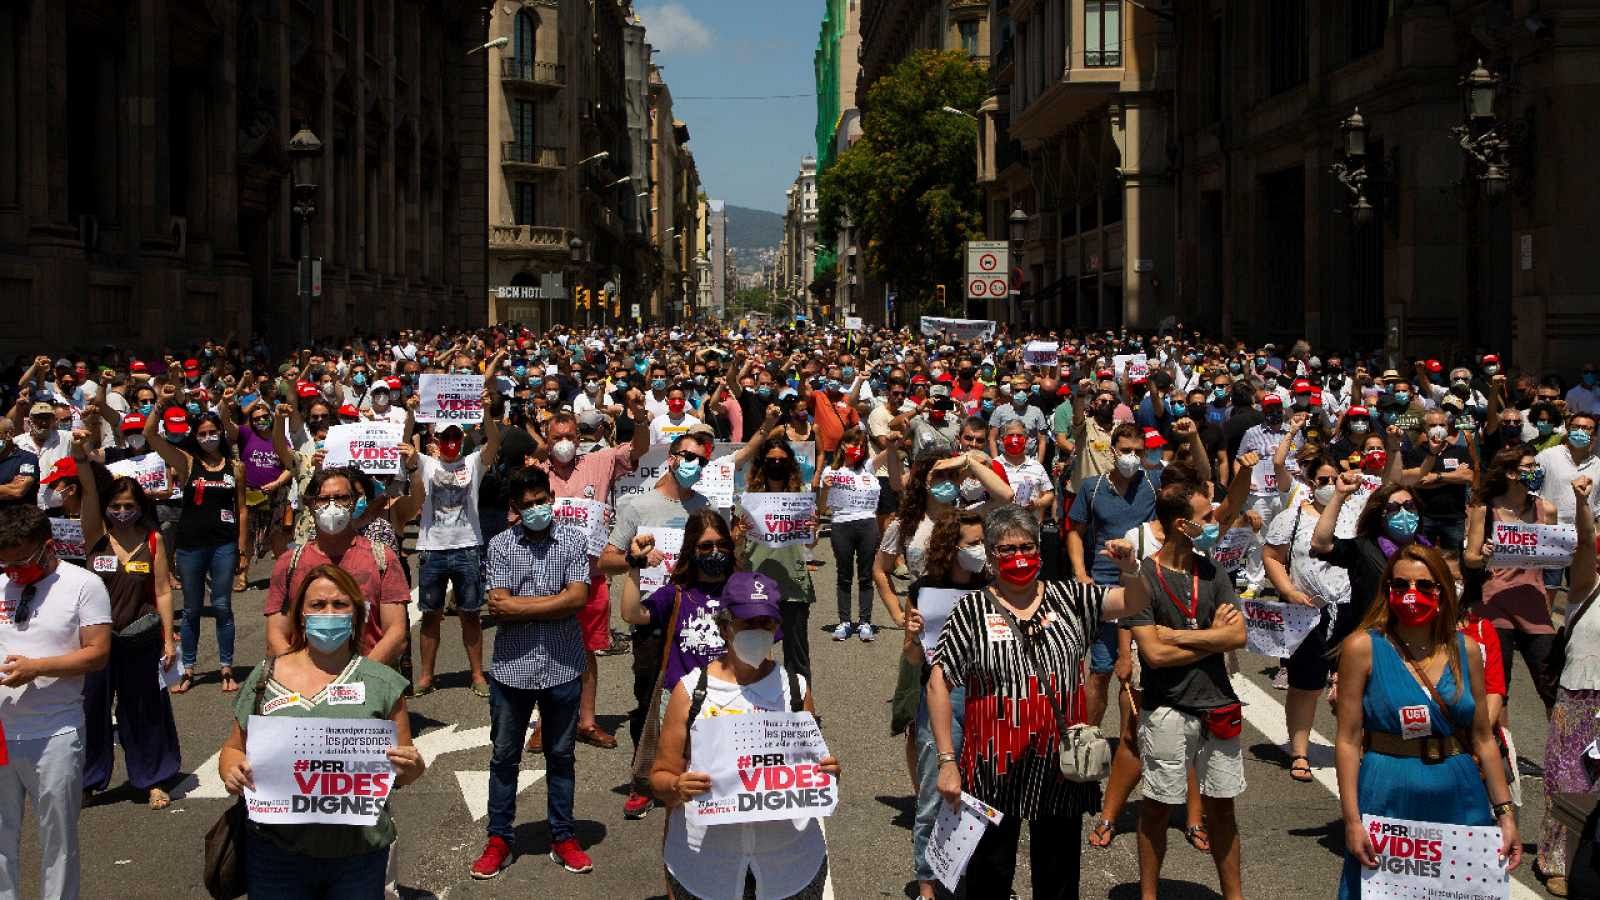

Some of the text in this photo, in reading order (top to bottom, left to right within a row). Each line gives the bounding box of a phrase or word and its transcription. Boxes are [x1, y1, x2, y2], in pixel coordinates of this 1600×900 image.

[437, 400, 480, 411] VIDES
[436, 410, 480, 420] DIGNES
[350, 447, 399, 460] VIDES
[640, 467, 660, 478] DE
[1497, 531, 1538, 546] VIDES
[1495, 545, 1537, 556] DIGNES
[1247, 608, 1283, 624] VIDES
[326, 735, 341, 746] les
[293, 760, 392, 773] #PERUNES
[294, 771, 390, 797] VIDES
[737, 764, 831, 792] VIDES
[292, 795, 386, 816] DIGNES
[738, 788, 833, 812] DIGNES
[1369, 821, 1443, 841] #PERUNES
[1370, 833, 1443, 862] VIDES
